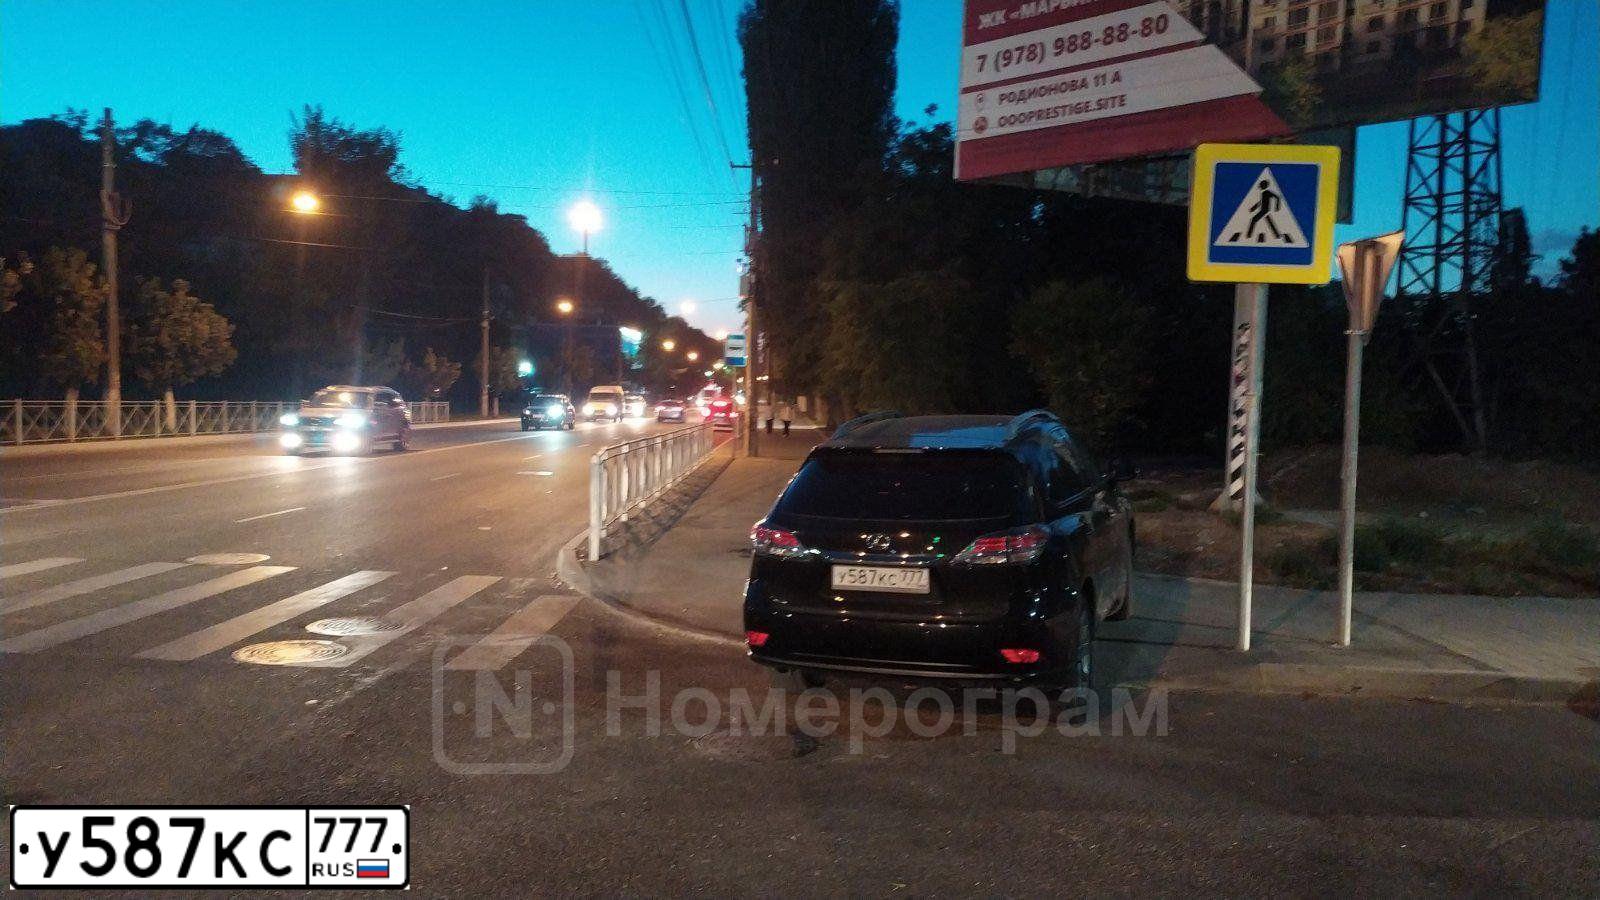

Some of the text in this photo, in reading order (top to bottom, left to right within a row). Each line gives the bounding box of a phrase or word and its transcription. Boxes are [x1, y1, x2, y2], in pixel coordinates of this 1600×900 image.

[976, 13, 1170, 73] 7 (978) 988-88-80
[998, 77, 1089, 106] РОДИОНОВА
[1093, 72, 1107, 88] 11
